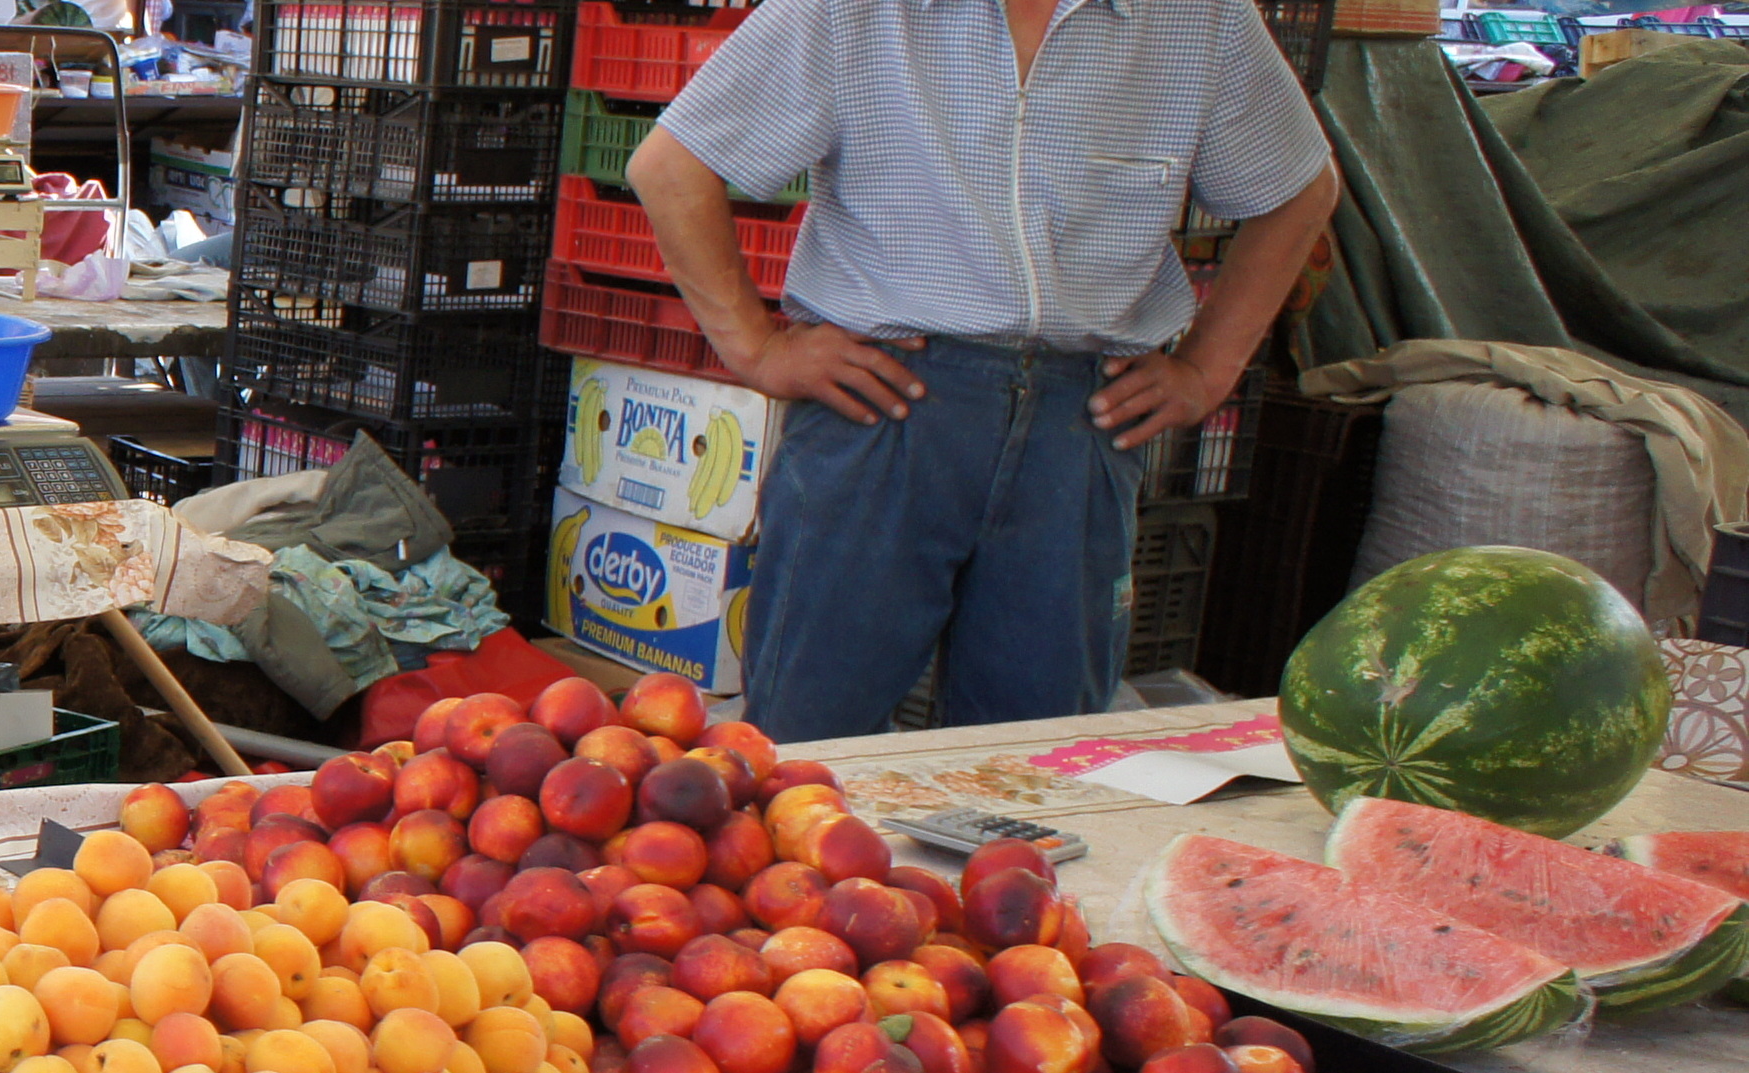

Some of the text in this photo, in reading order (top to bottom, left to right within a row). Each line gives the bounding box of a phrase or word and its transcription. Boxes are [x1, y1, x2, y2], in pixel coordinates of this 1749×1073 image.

[626, 377, 696, 407] PREMIUM PACK
[616, 397, 686, 464] BONITA
[660, 532, 718, 560] PRODUCE OF
[589, 532, 661, 606] derby
[670, 549, 716, 574] ECUADOR
[600, 598, 634, 618] QUALITY
[581, 619, 704, 681] PREMIUM BANANAS
